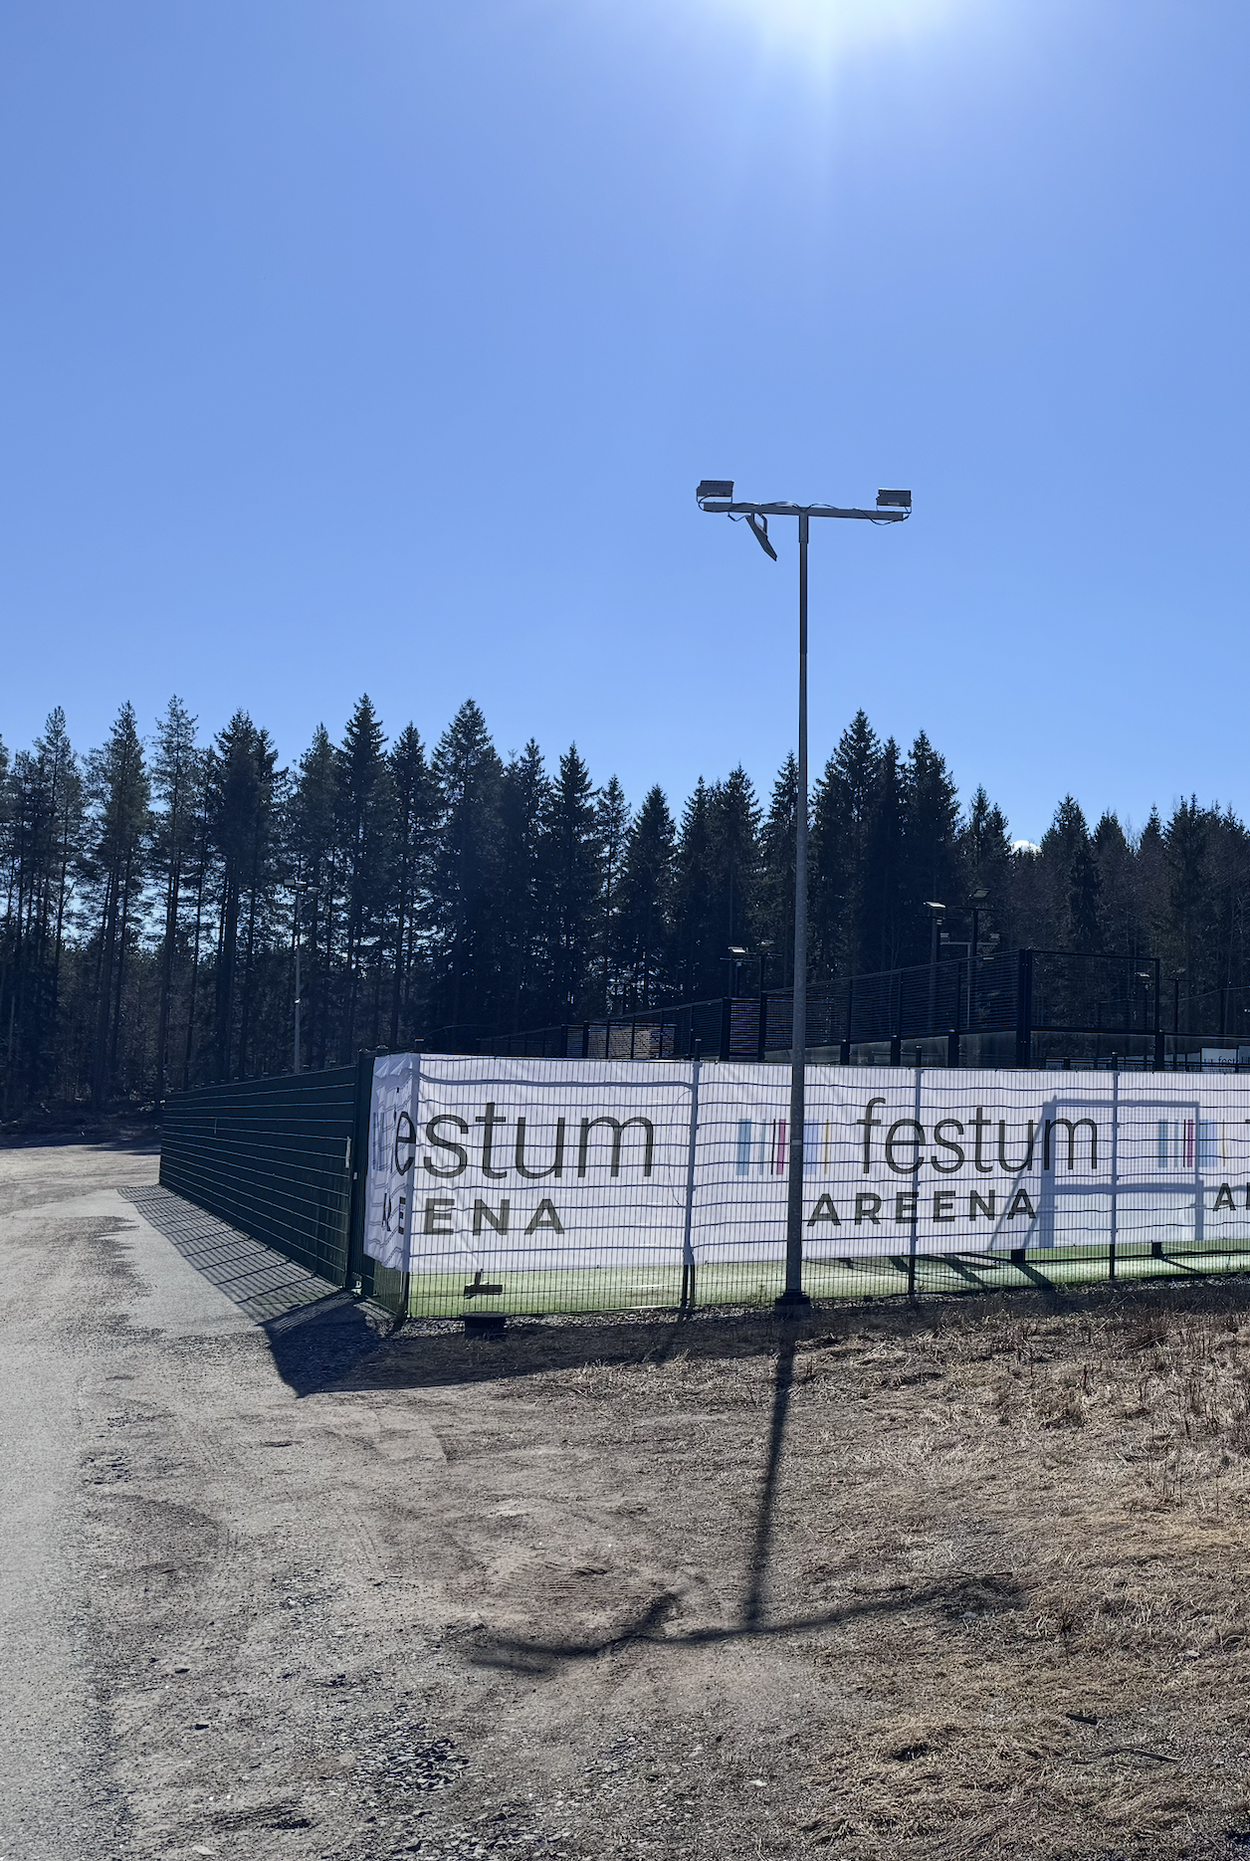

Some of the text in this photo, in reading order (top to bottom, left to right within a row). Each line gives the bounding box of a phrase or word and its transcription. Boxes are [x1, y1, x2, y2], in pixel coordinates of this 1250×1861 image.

[391, 1090, 654, 1180] estum
[857, 1097, 1098, 1175] festum
[806, 1187, 1038, 1227] AREENA
